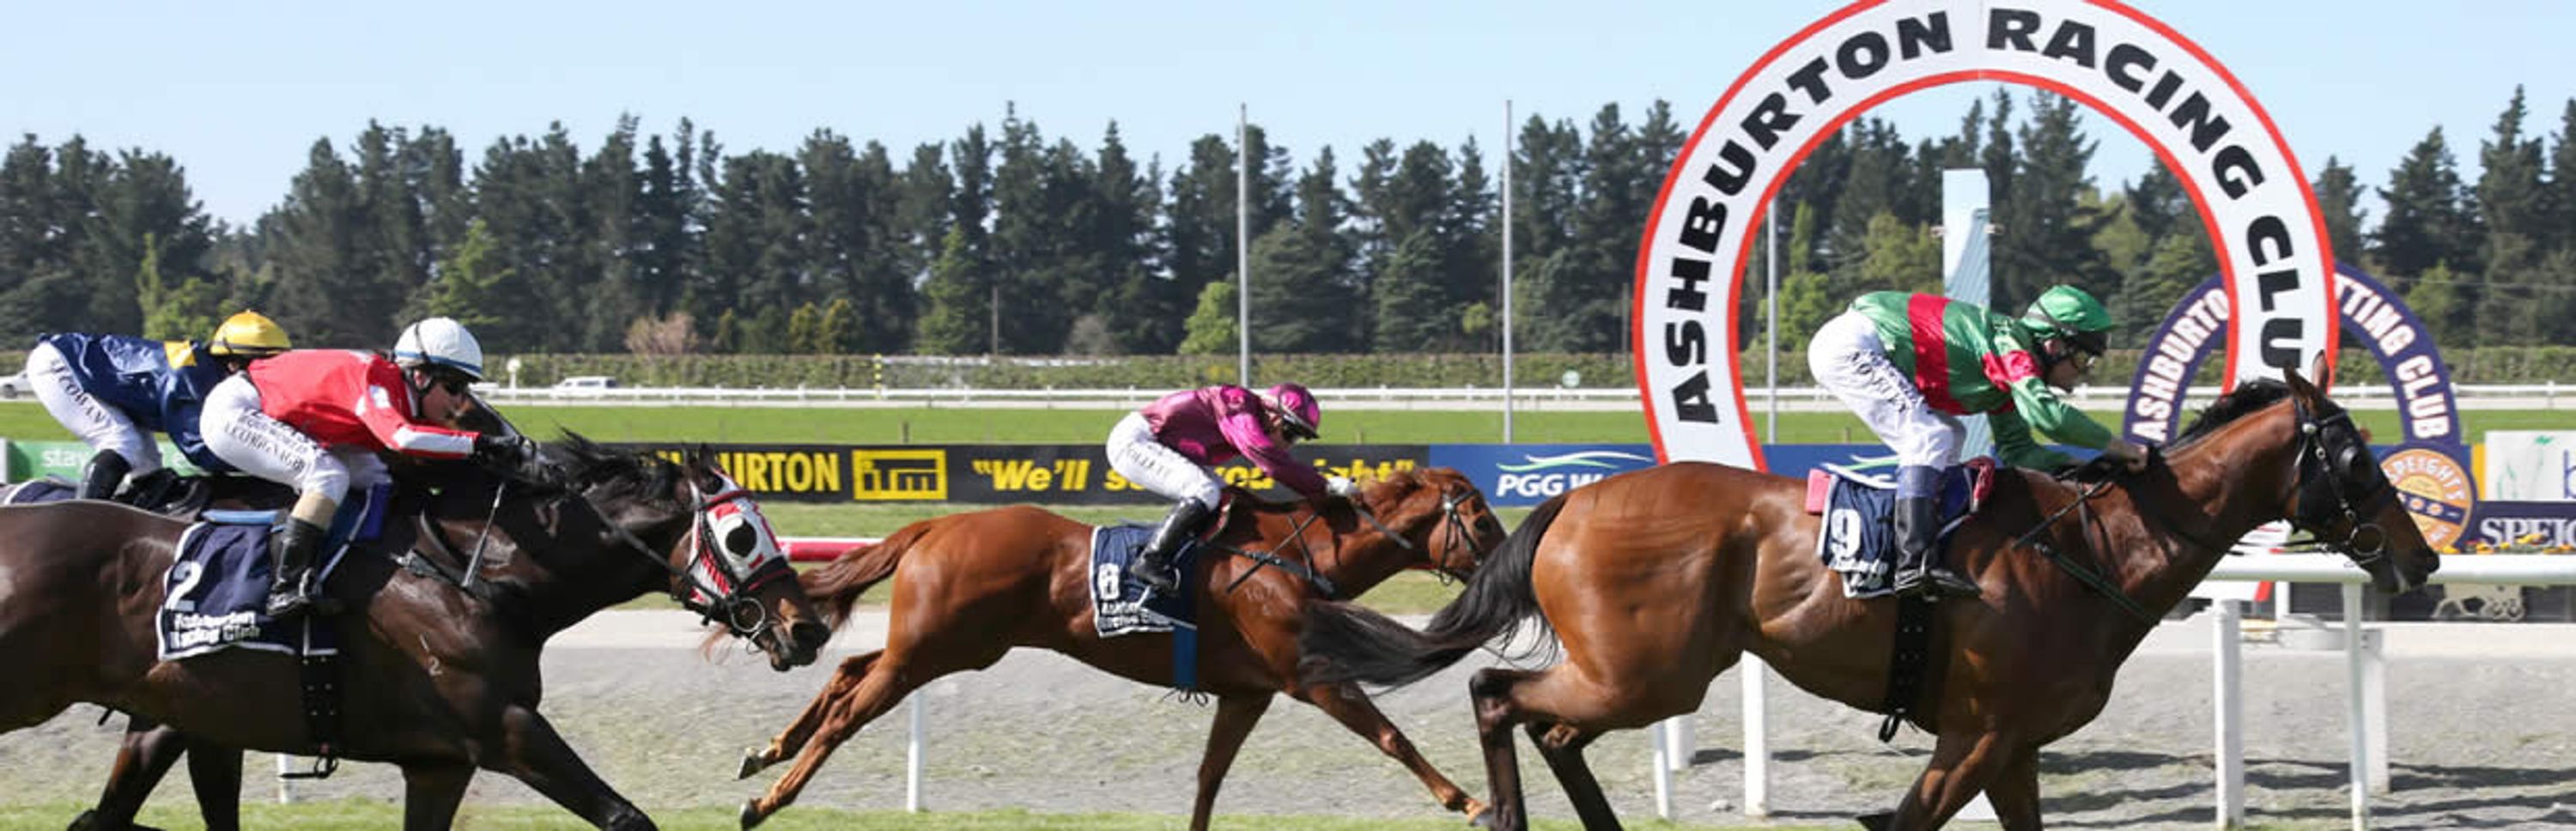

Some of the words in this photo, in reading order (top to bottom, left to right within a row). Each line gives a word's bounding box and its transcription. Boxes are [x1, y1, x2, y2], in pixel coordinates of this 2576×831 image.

[1664, 10, 1953, 425] ASHBURTON
[1986, 8, 2265, 200] RACING
[2246, 215, 2304, 369] CLU
[2131, 288, 2230, 442] ASHBURTO
[2395, 355, 2451, 440] CLUB
[1495, 474, 1564, 497] PGG
[1830, 509, 1862, 560] 9
[165, 561, 202, 611] 2
